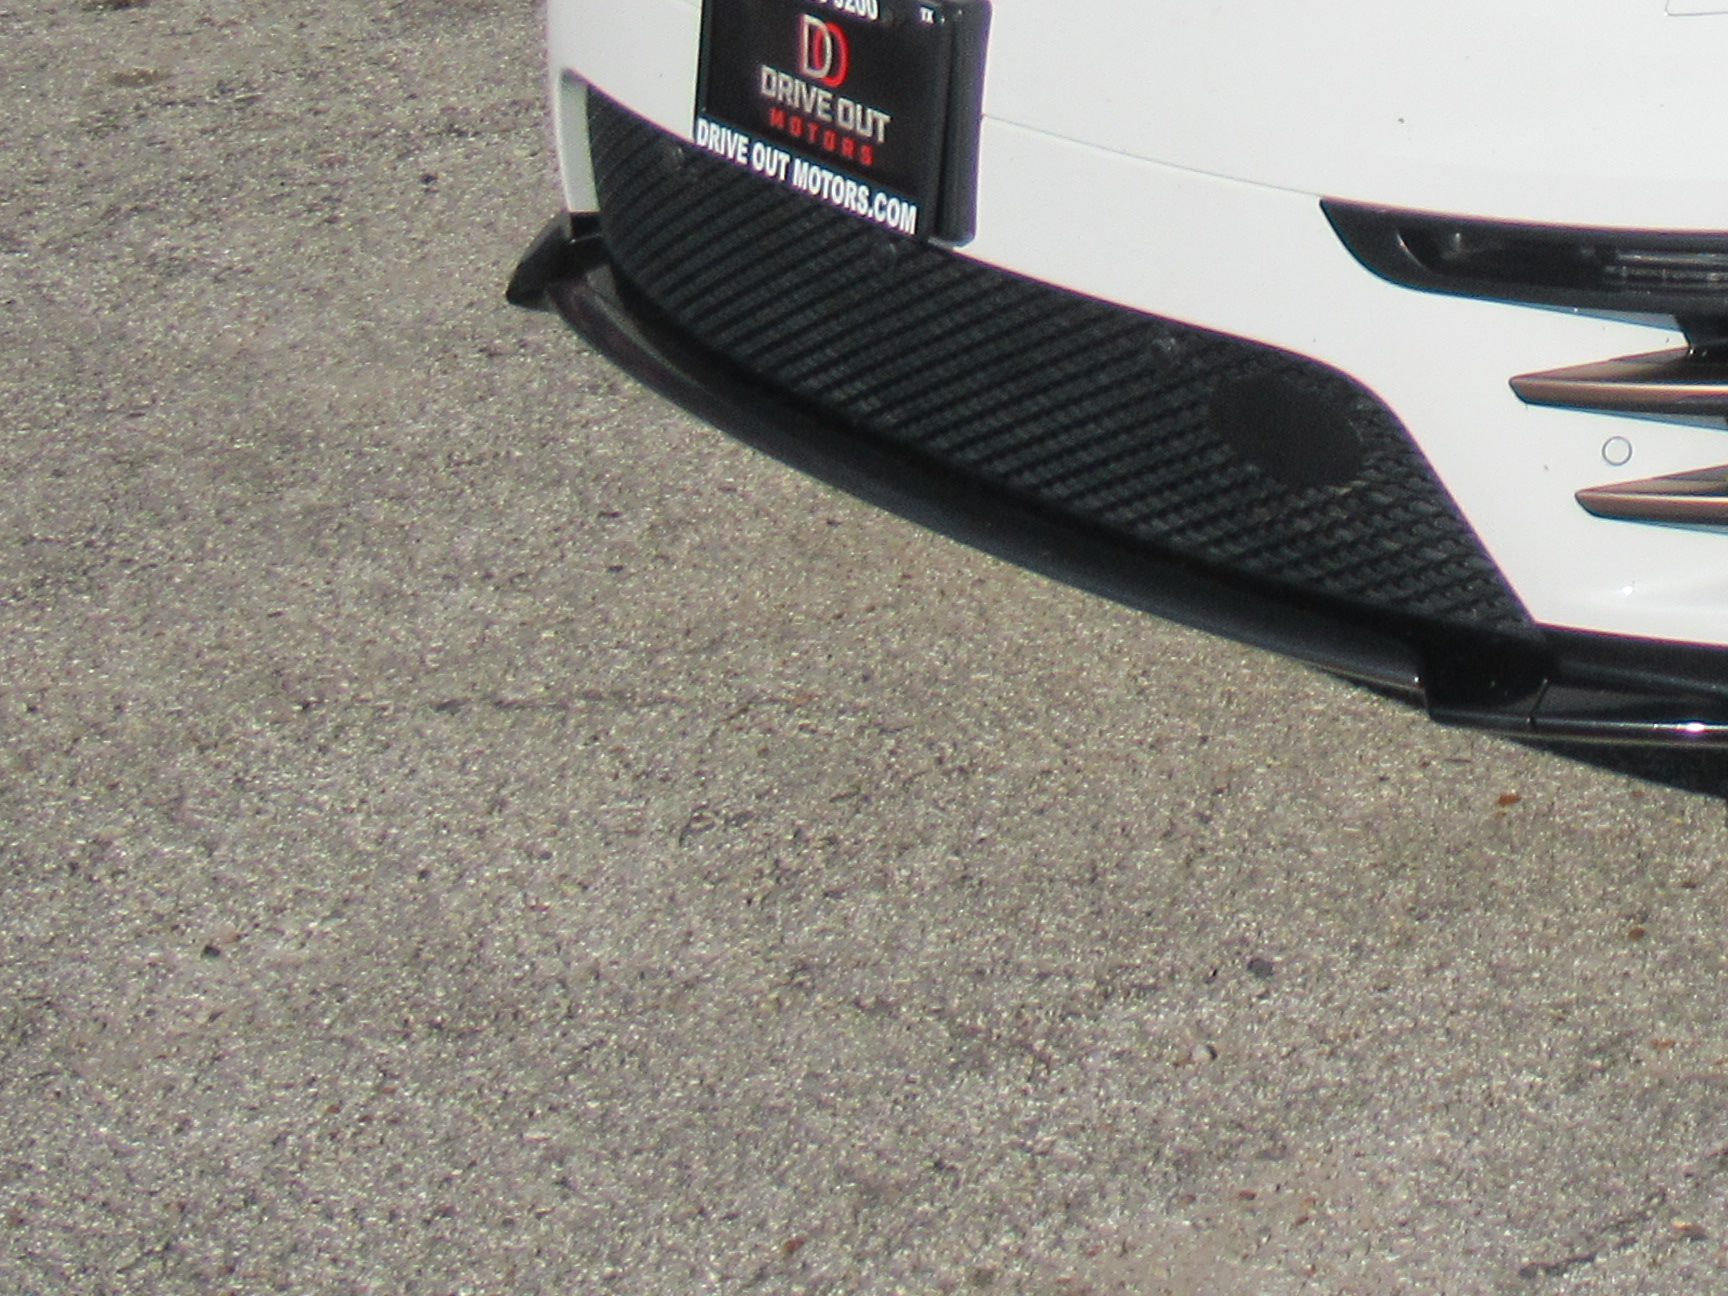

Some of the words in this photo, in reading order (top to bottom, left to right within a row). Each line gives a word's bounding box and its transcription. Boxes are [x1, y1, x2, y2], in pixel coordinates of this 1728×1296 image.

[760, 64, 833, 123] DRIVE
[837, 96, 892, 144] OUT
[769, 107, 875, 166] MOTORS
[696, 116, 749, 165] DRIVE
[752, 141, 790, 182] OUT
[792, 158, 917, 235] MOTORS.COM
